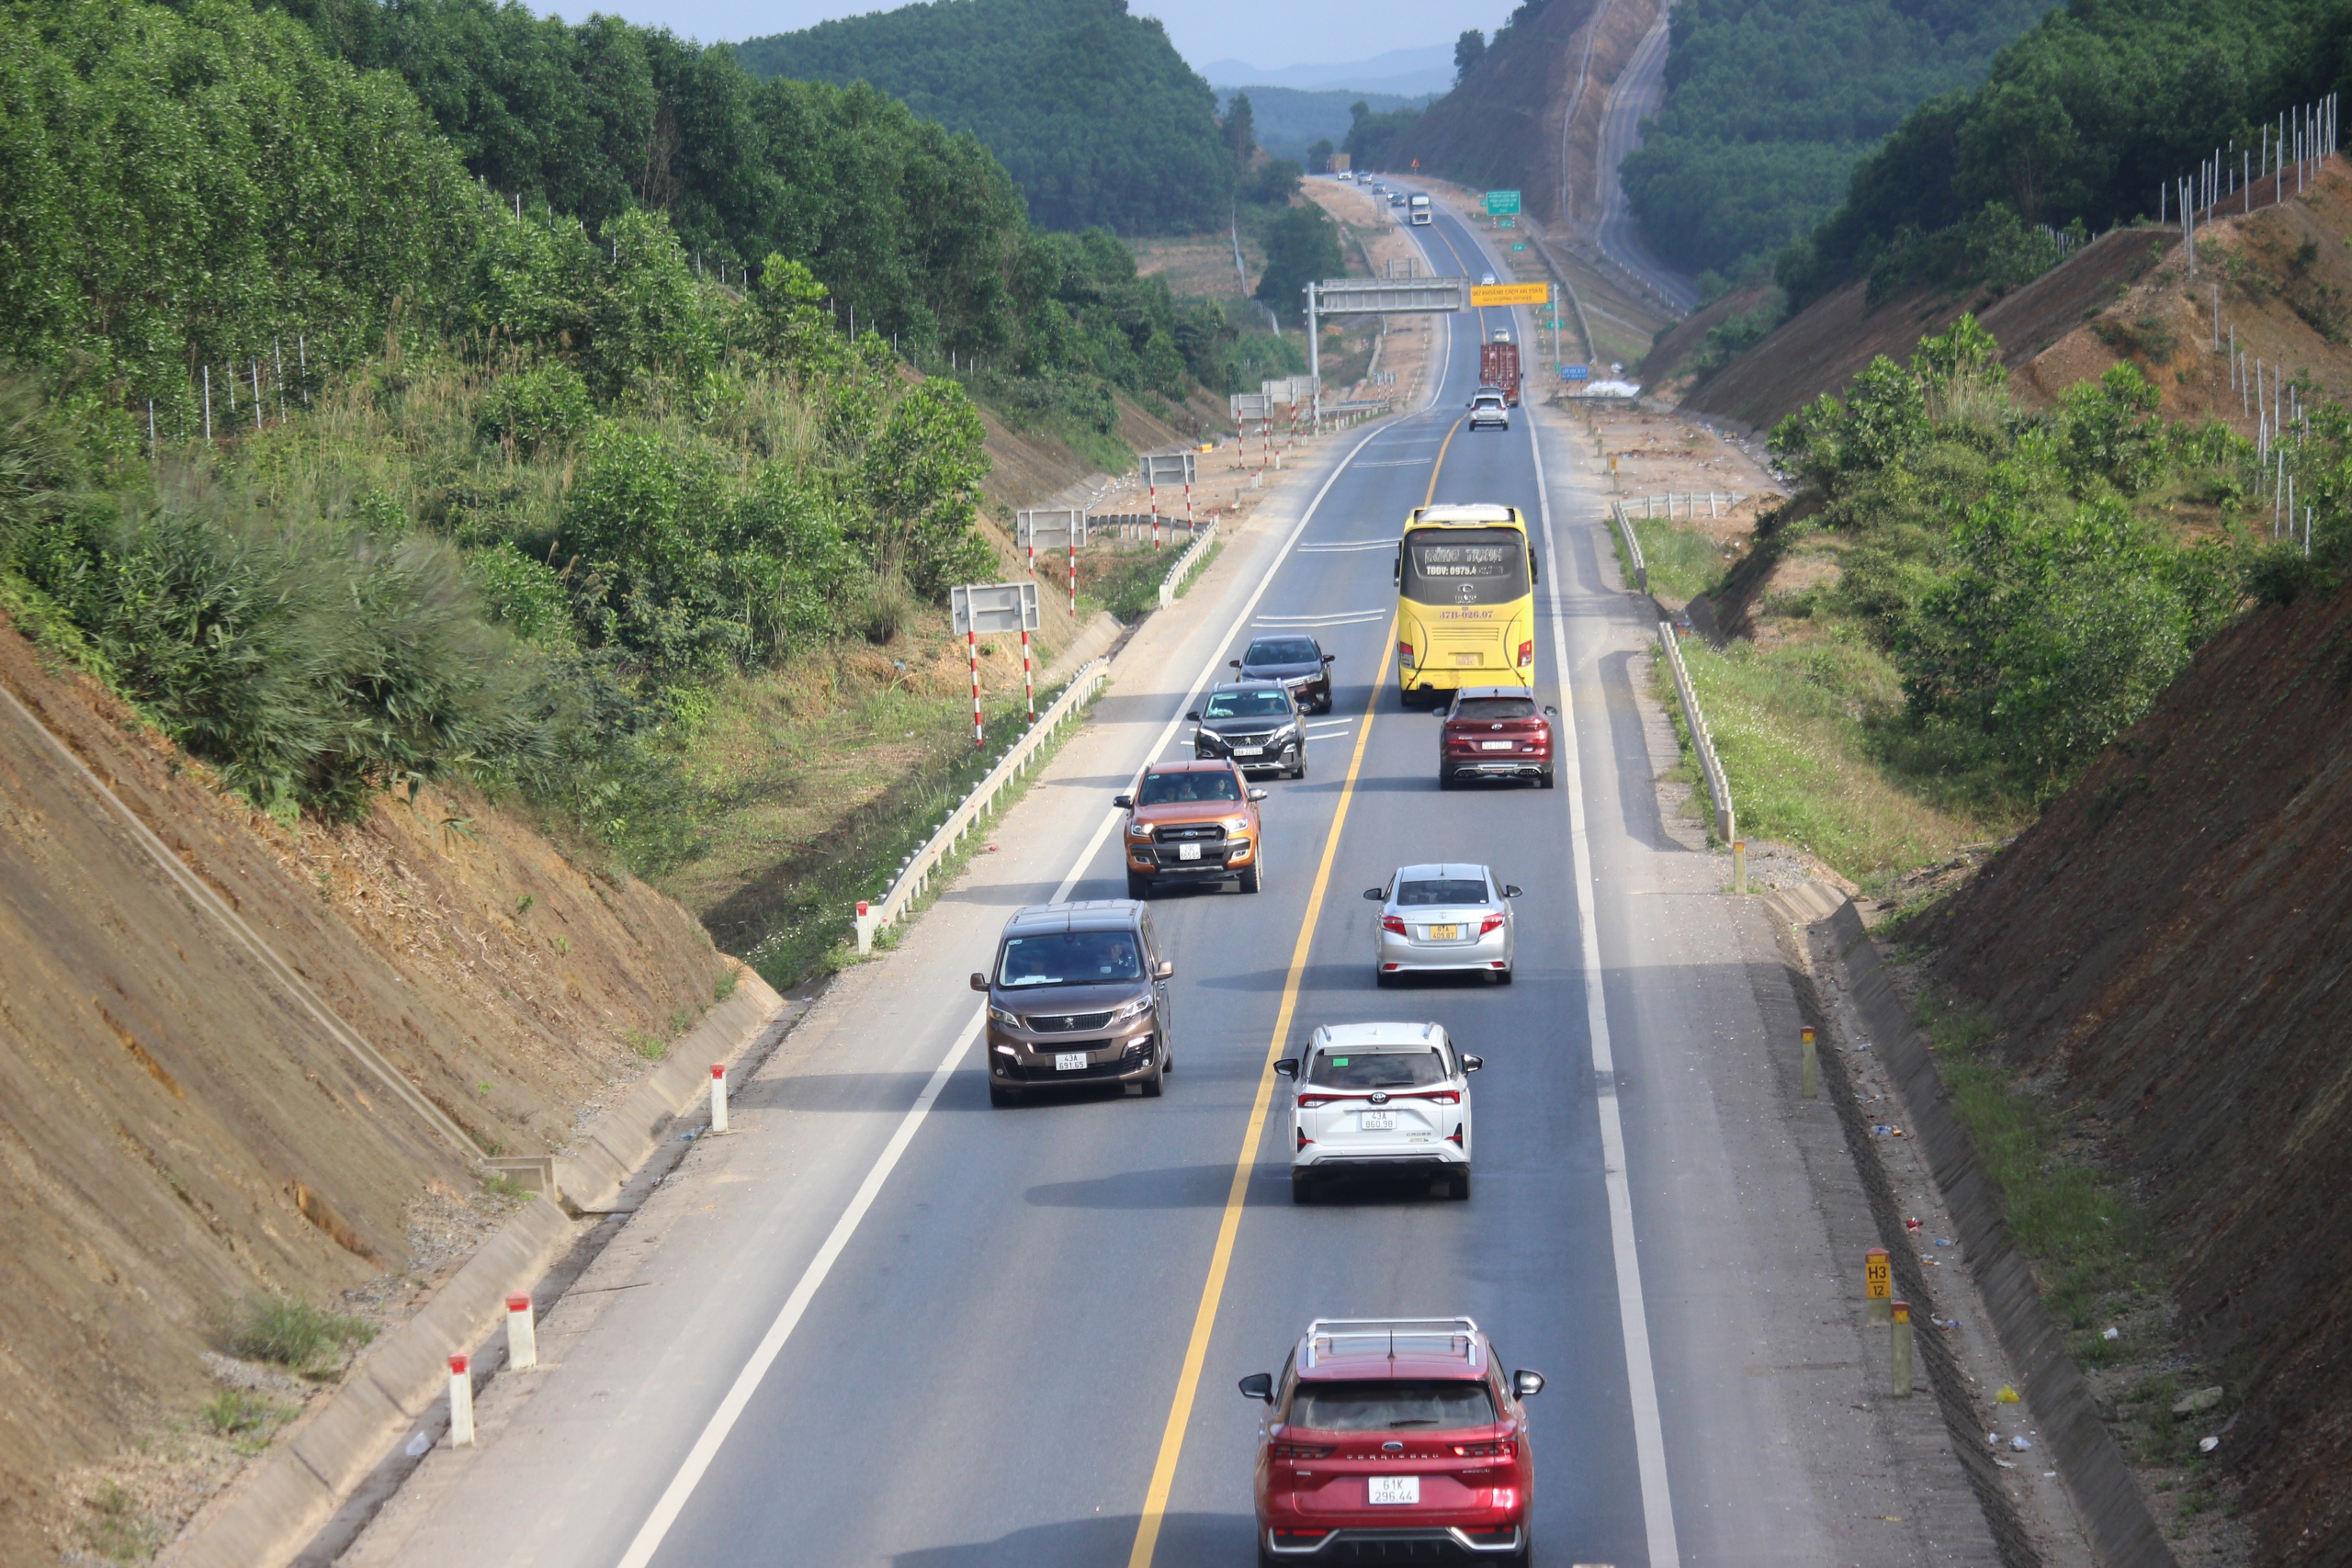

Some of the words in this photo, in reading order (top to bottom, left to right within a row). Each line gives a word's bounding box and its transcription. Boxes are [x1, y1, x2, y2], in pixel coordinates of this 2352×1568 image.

[1372, 1111, 1386, 1120] 43A
[1365, 1120, 1393, 1128] 860.98
[1869, 1266, 1886, 1280] H3
[1873, 1286, 1883, 1296] 12
[1383, 1479, 1404, 1490] 61K
[1375, 1492, 1412, 1502] 296.44
